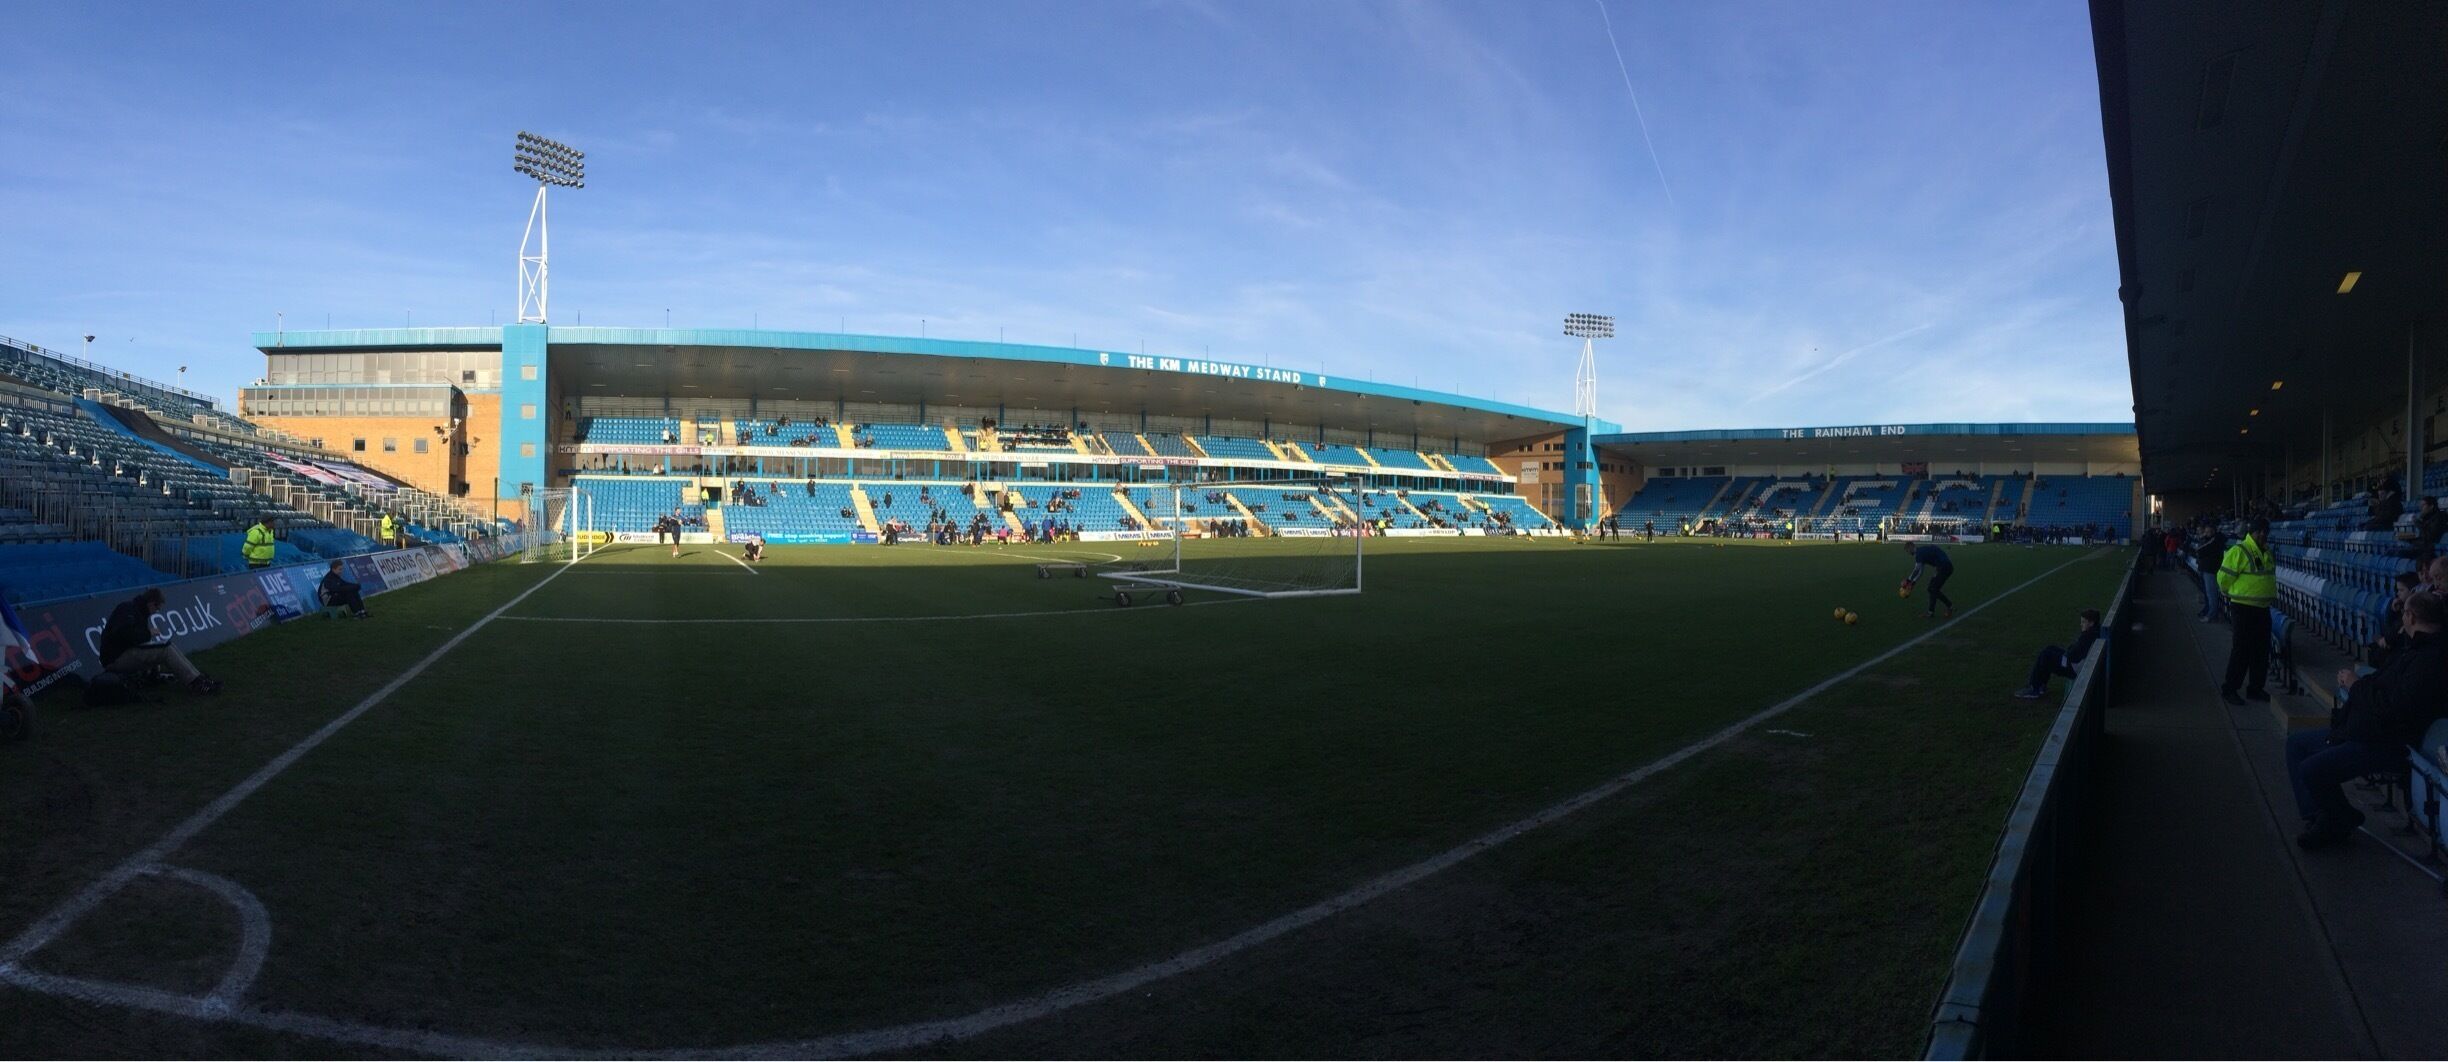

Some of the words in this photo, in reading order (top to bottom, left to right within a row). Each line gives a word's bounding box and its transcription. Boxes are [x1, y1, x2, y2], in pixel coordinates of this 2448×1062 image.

[1128, 355, 1153, 369] THE
[1159, 357, 1180, 371] KM
[1187, 360, 1250, 377] MEDWAY
[1257, 368, 1301, 383] STAND
[1782, 429, 1804, 438] THE
[1815, 427, 1873, 438] RAINHAM
[1881, 425, 1905, 435] END
[595, 446, 652, 454] SUPPORTING
[1121, 457, 1164, 465] SUPPORTING
[377, 554, 417, 575] HIDSONS
[259, 572, 291, 595] LIVE
[22, 674, 54, 697] BUILDING
[53, 658, 82, 681] INTERIORS
